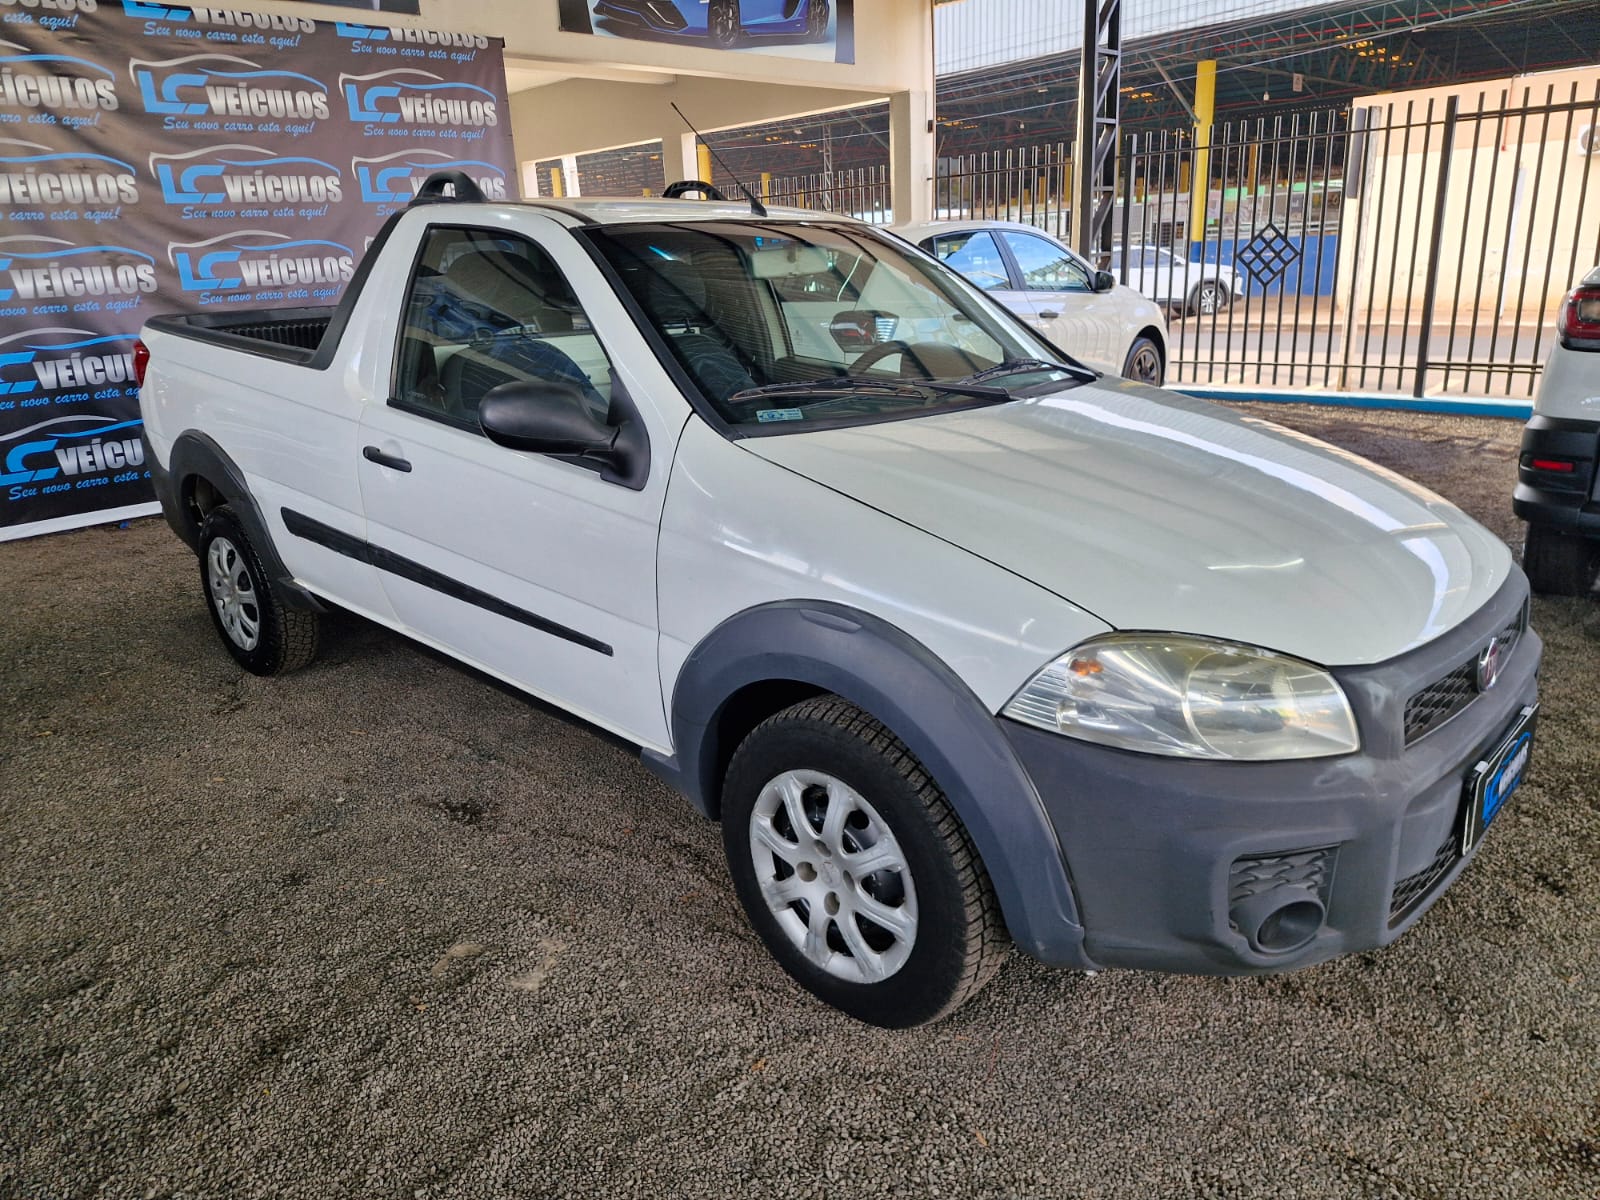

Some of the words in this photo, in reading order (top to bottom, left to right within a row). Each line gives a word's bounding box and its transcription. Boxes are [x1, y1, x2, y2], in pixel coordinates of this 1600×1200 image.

[39, 14, 79, 30] aqui!
[143, 22, 171, 36] Seu
[175, 27, 201, 38] novo
[206, 30, 238, 41] carro
[242, 33, 266, 44] esta
[269, 34, 301, 49] aqui!
[351, 40, 372, 53] Seu
[376, 45, 397, 54] novo
[400, 48, 425, 58] carro
[428, 49, 447, 59] esta
[450, 50, 476, 65] aqui!
[0, 67, 119, 111] ÍCULOS
[27, 112, 57, 125] esta
[62, 112, 101, 130] aqui!
[163, 116, 189, 130] Seu
[193, 121, 219, 130] novo
[223, 122, 254, 132] carro
[257, 122, 281, 133] esta
[284, 121, 316, 137] aqui!
[363, 124, 384, 137] Seu
[387, 128, 409, 137] novo
[412, 129, 436, 138] carro
[439, 128, 458, 139] esta
[461, 128, 486, 142] aqui!
[9, 210, 46, 221] carro
[50, 208, 79, 221] esta
[83, 207, 122, 225] aqui!
[181, 206, 207, 220] Seu
[211, 209, 236, 219] novo
[240, 208, 269, 218] carro
[273, 206, 295, 218] esta
[299, 204, 329, 220] aqui!
[32, 303, 69, 315] carro
[73, 300, 101, 312] esta
[105, 295, 141, 314] aqui!
[199, 292, 223, 305] Seu
[227, 294, 251, 303] novo
[255, 291, 283, 301] carro
[287, 288, 309, 299] esta
[312, 284, 342, 300] aqui!
[0, 401, 16, 410] eu
[20, 397, 50, 408] novo
[55, 393, 90, 404] carro
[94, 388, 121, 400] esta
[54, 437, 146, 477] VEÍCU
[8, 486, 38, 501] Seu
[42, 482, 72, 495] novo
[76, 476, 109, 490] carro
[113, 470, 140, 484] esta
